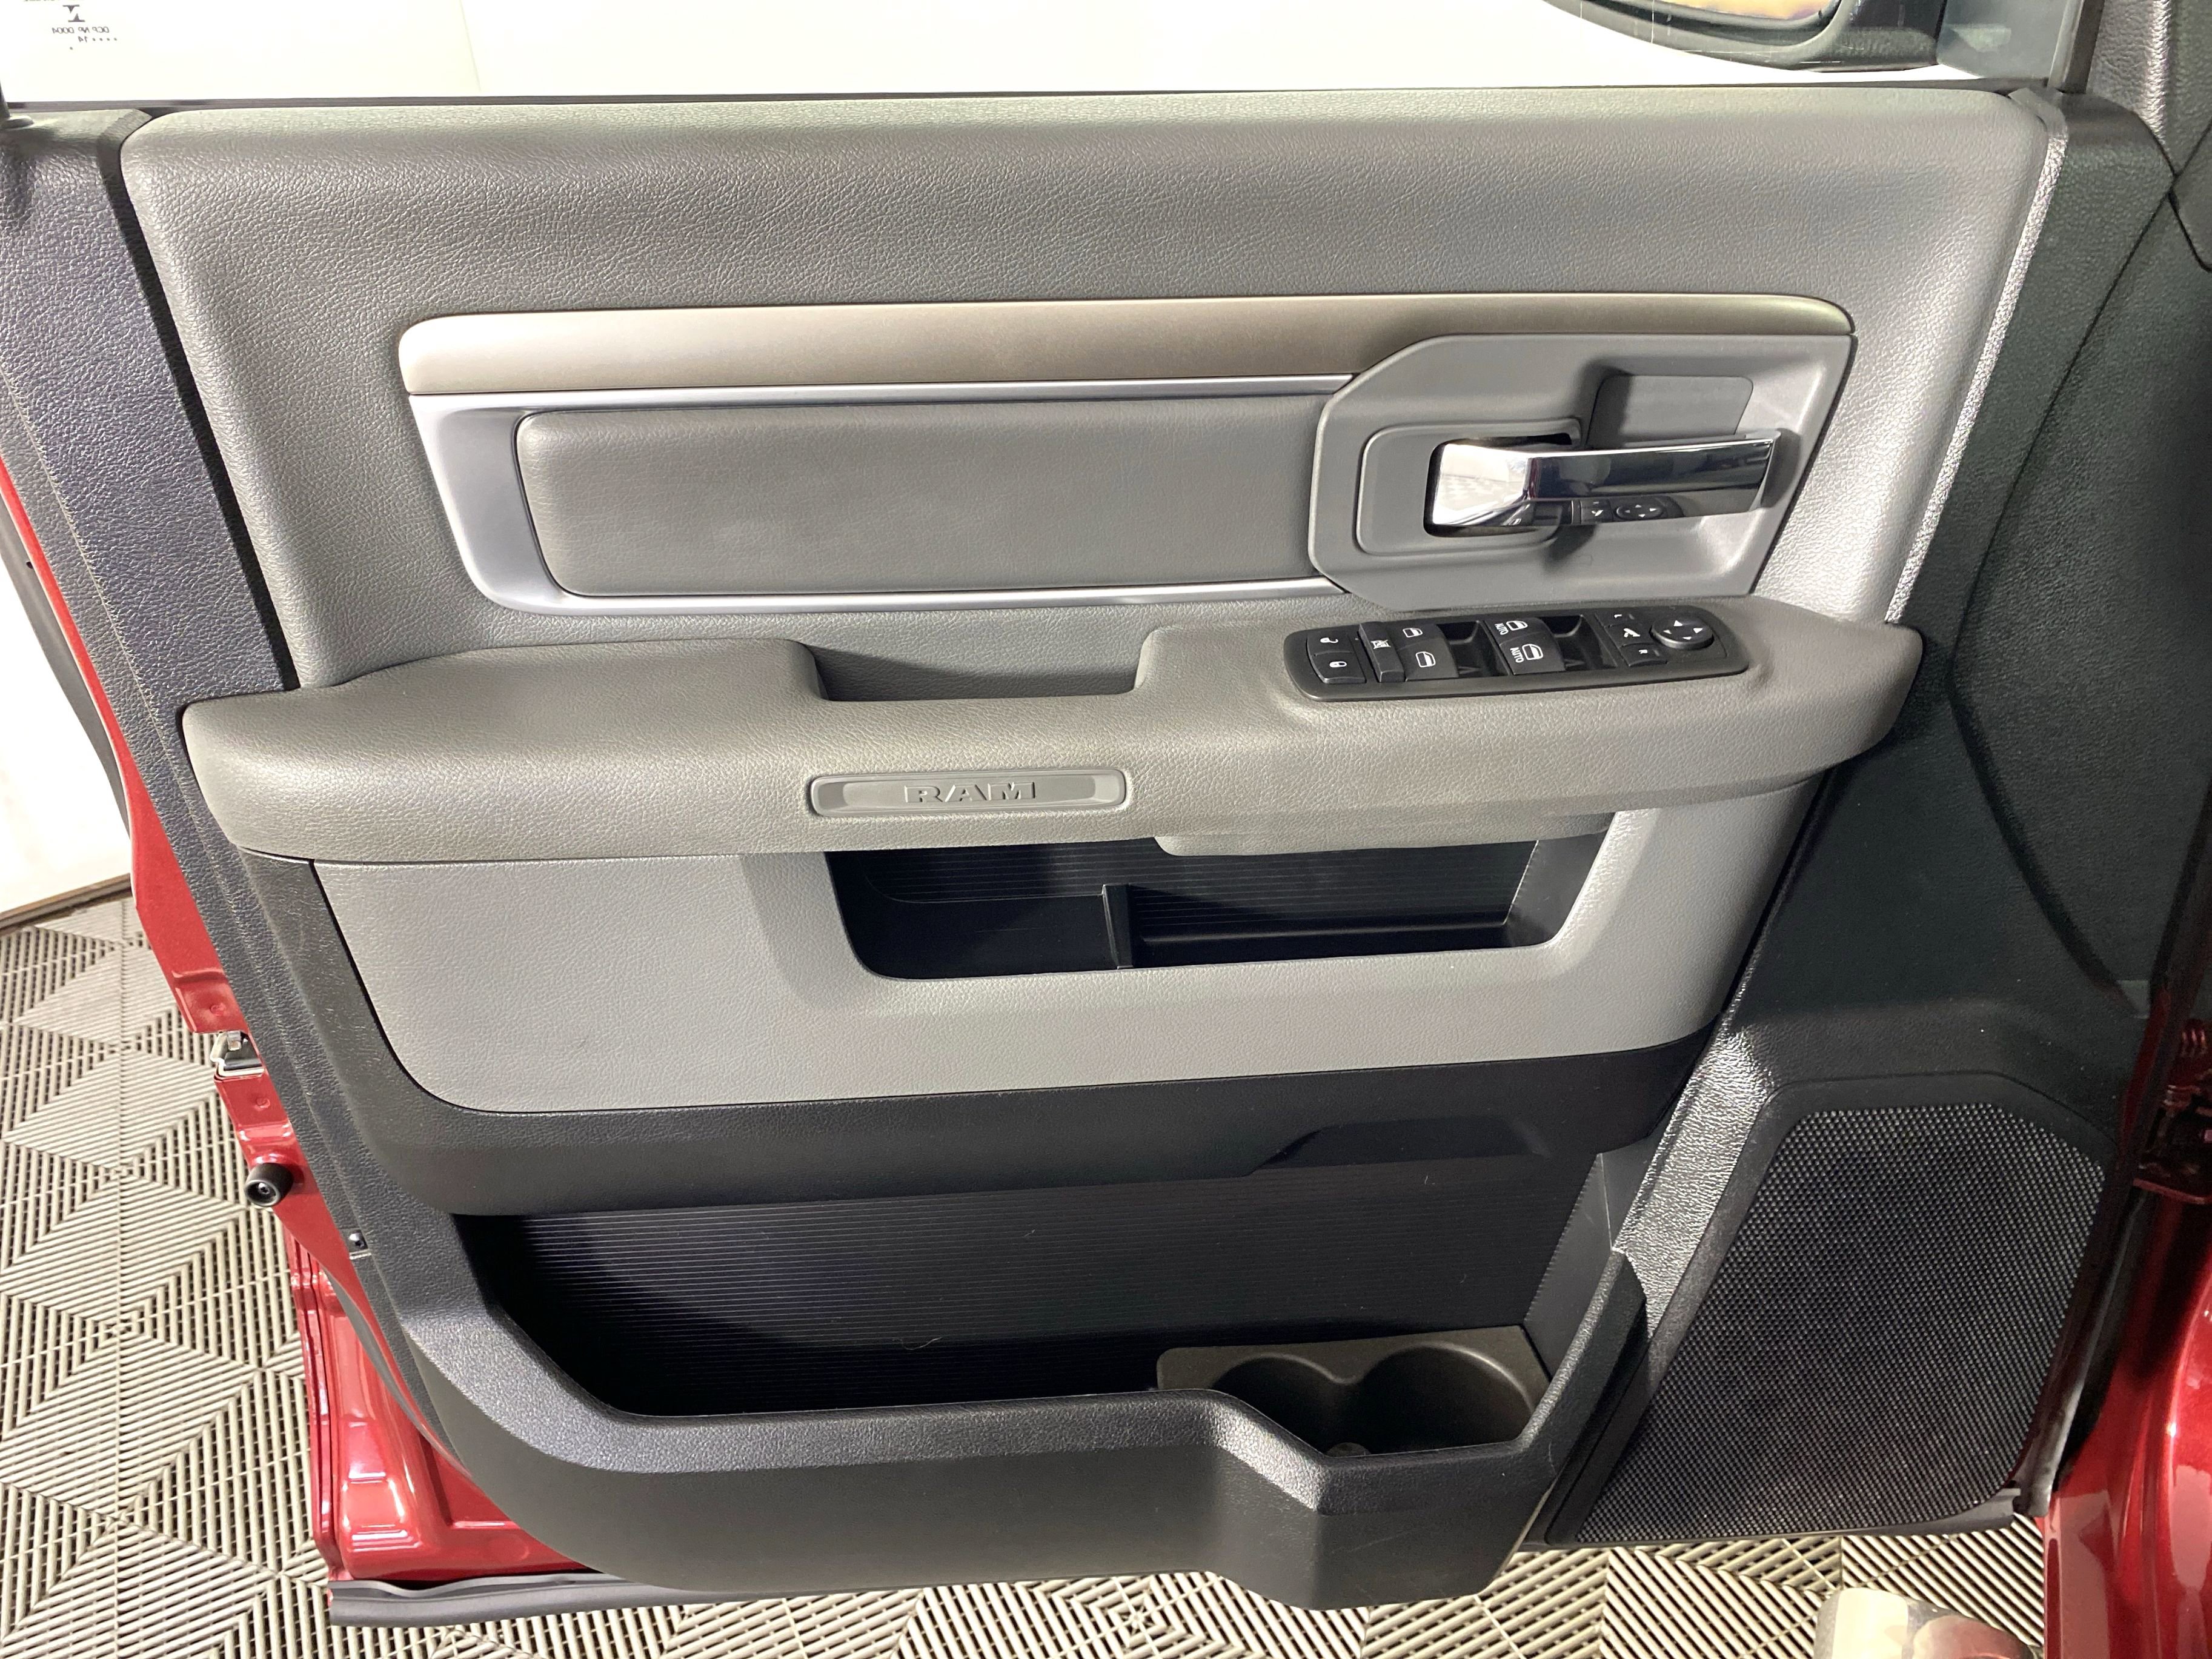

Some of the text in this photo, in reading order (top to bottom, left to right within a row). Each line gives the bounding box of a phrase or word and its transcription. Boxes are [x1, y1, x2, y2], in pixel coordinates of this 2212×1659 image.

[1495, 623, 1509, 635] AUTO
[1510, 647, 1524, 663] AUTO
[904, 782, 1036, 803] RAM
